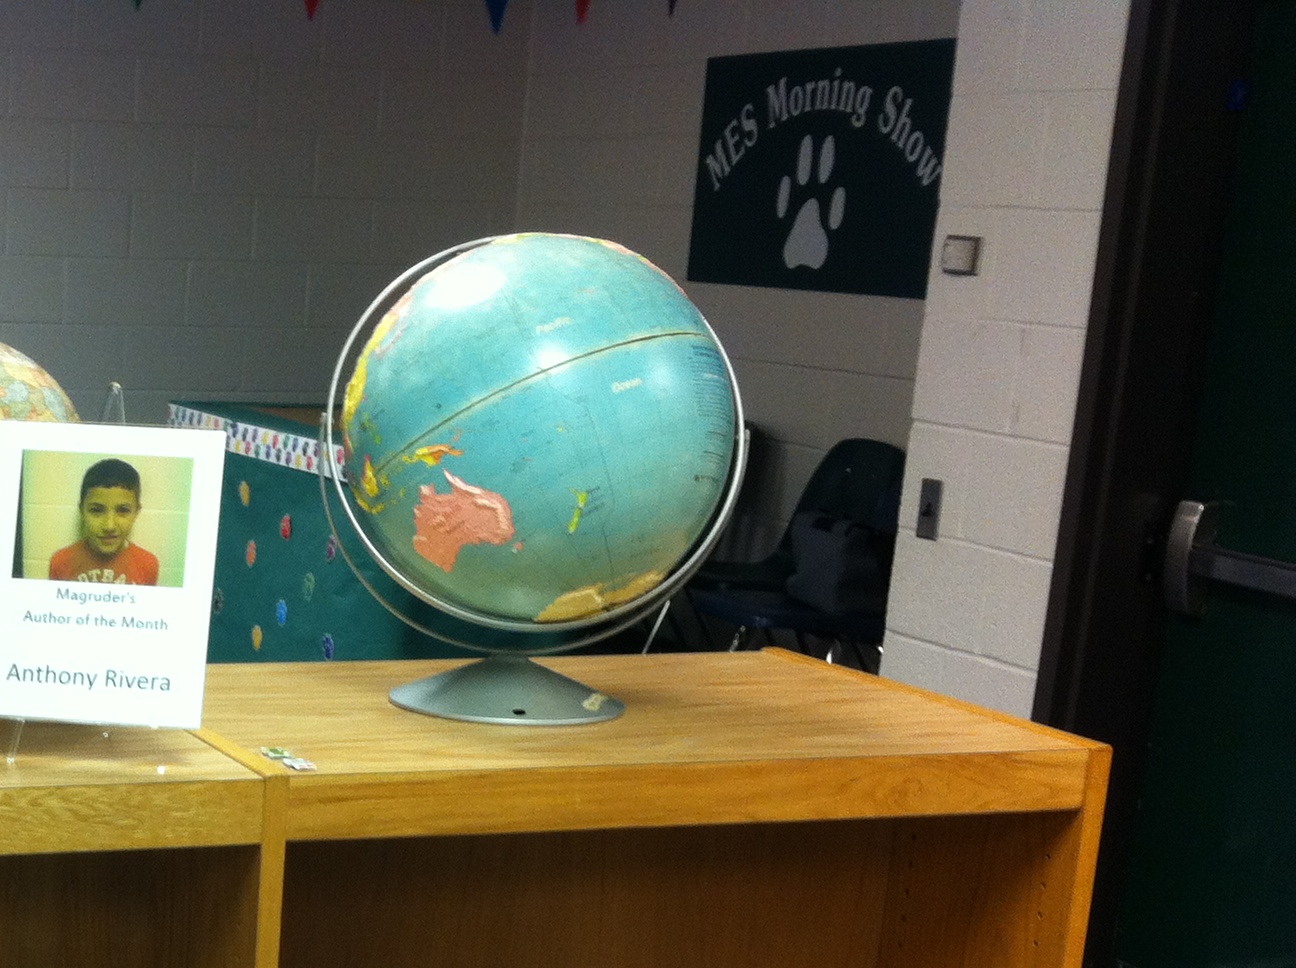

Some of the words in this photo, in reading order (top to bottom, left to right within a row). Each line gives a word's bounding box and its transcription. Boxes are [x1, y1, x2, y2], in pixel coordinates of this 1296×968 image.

[705, 103, 758, 191] MES
[766, 67, 873, 129] Morning
[878, 86, 942, 187] Show
[56, 588, 136, 605] Magruder's
[23, 610, 72, 626] Author
[76, 614, 91, 626] of
[94, 615, 117, 628] the
[121, 616, 169, 631] Month
[6, 663, 98, 691] Anthony
[105, 669, 171, 692] Rivera
